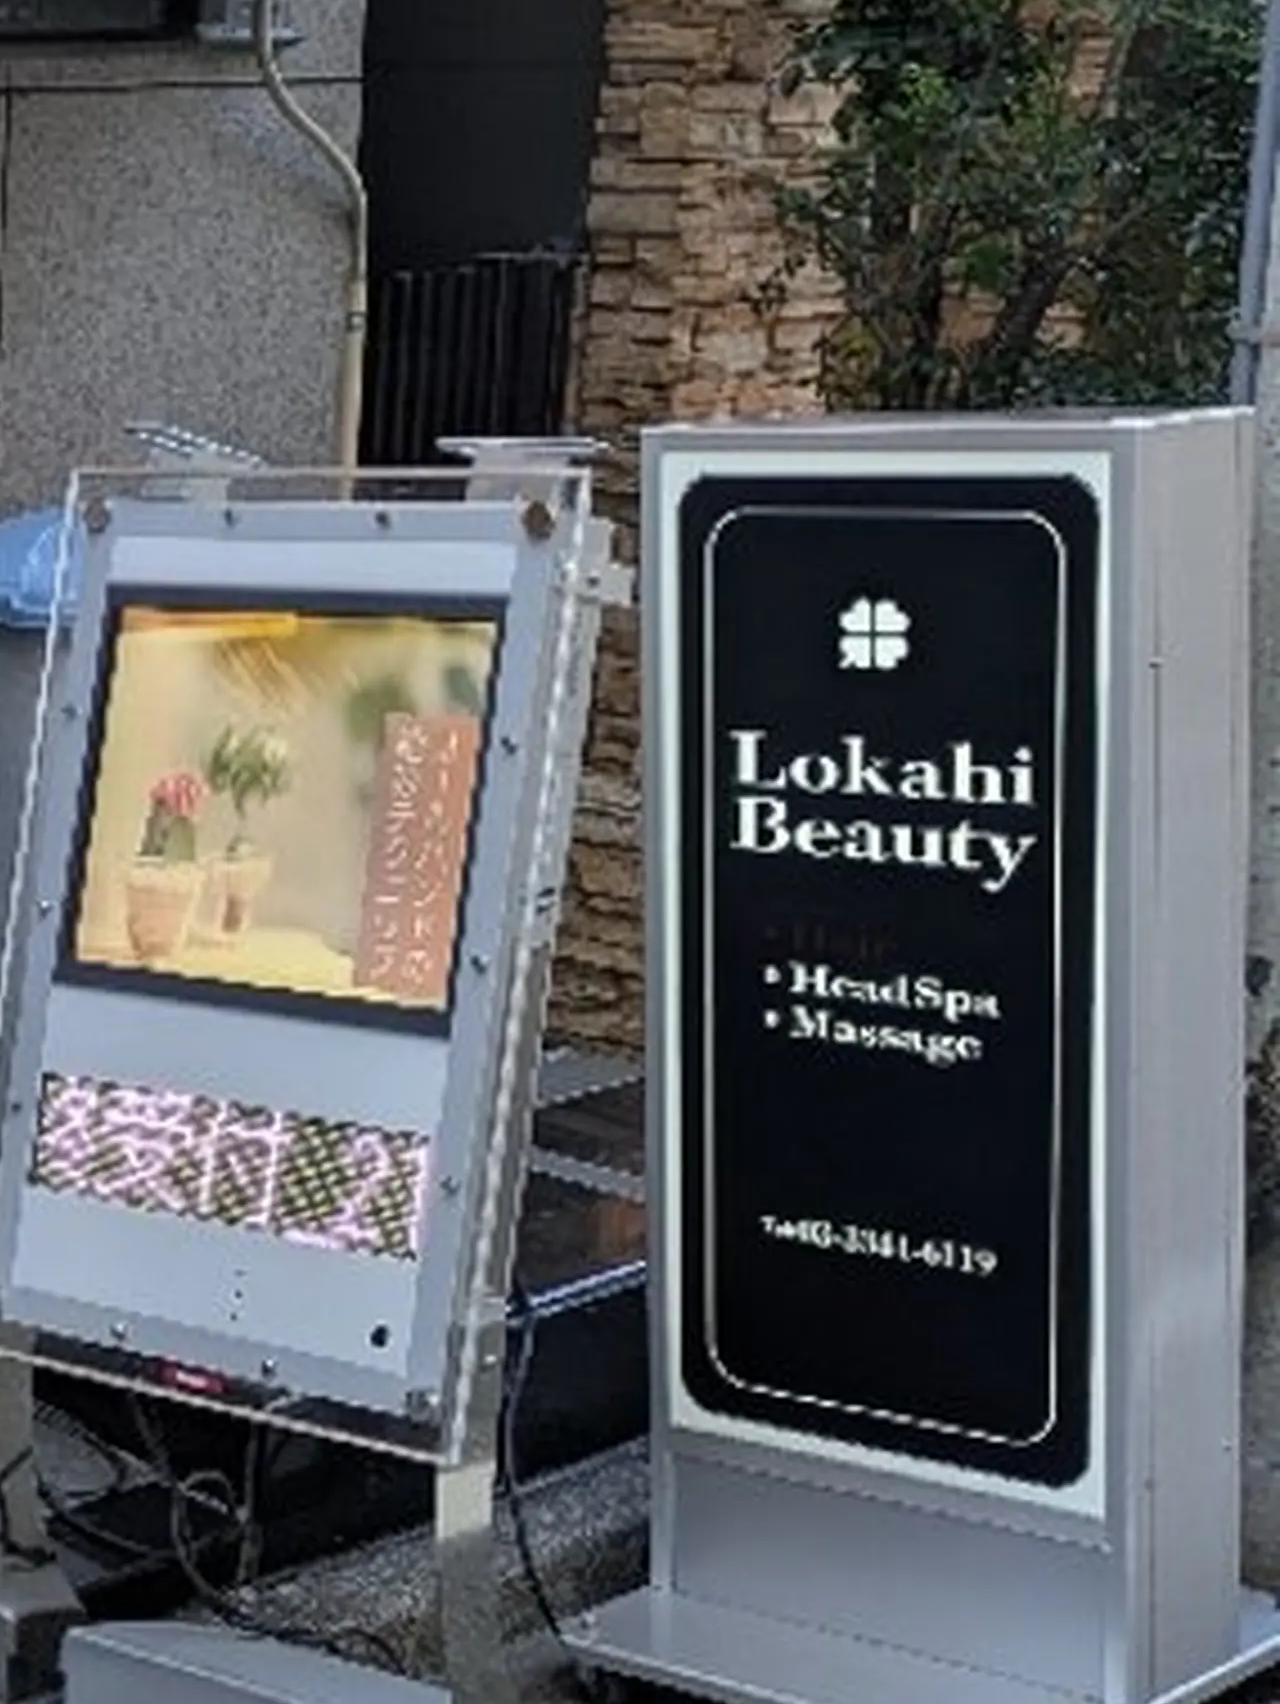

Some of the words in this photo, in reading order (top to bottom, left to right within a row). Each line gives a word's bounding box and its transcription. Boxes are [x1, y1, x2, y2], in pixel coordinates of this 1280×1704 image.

[728, 730, 1037, 806] Lokahi
[730, 799, 1037, 894] Beauty
[789, 1005, 983, 1068] Massage
